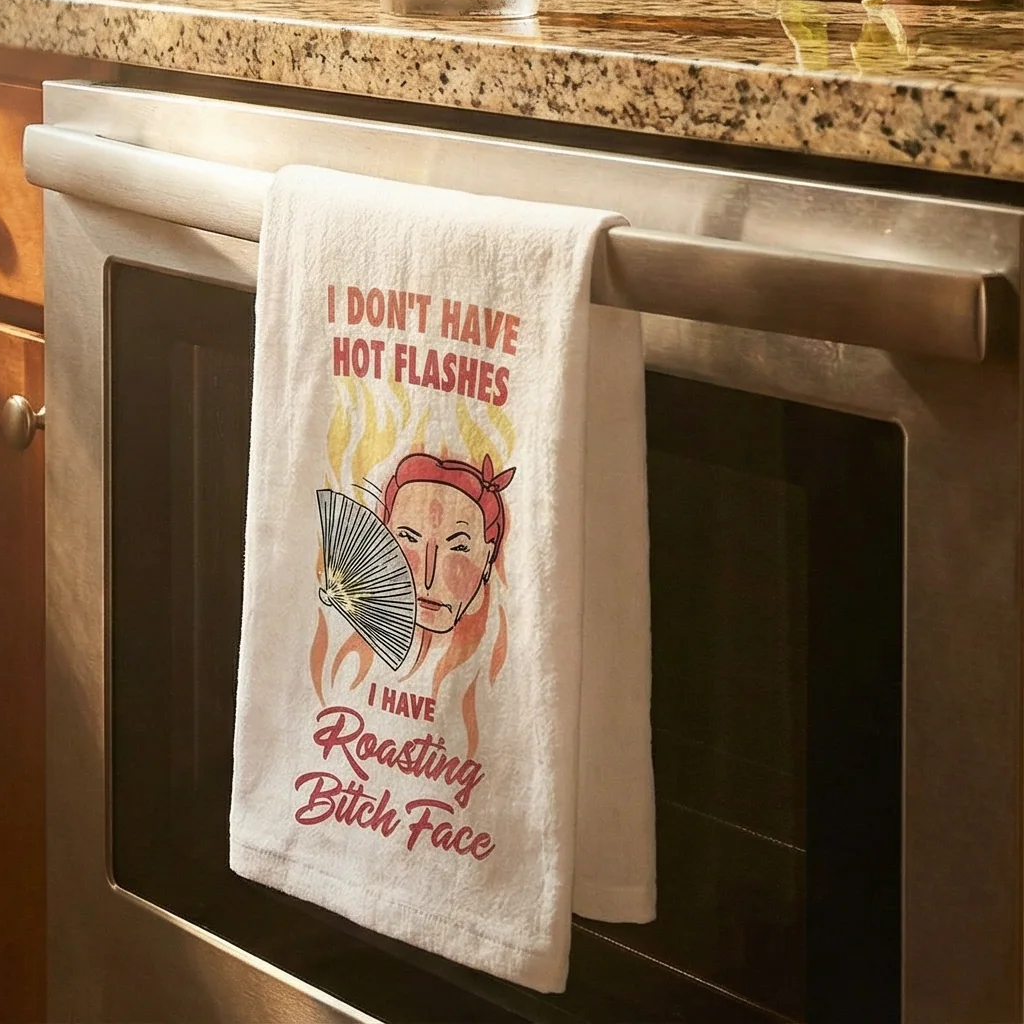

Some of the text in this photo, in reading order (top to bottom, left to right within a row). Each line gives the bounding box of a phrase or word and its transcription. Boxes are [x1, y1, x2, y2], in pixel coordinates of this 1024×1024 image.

[328, 284, 521, 356] I DON'T HAVE
[333, 337, 510, 407] HOT FLASHES
[368, 682, 436, 722] I HAVE
[313, 706, 485, 809] Roasting
[294, 771, 496, 861] Bitch Face
